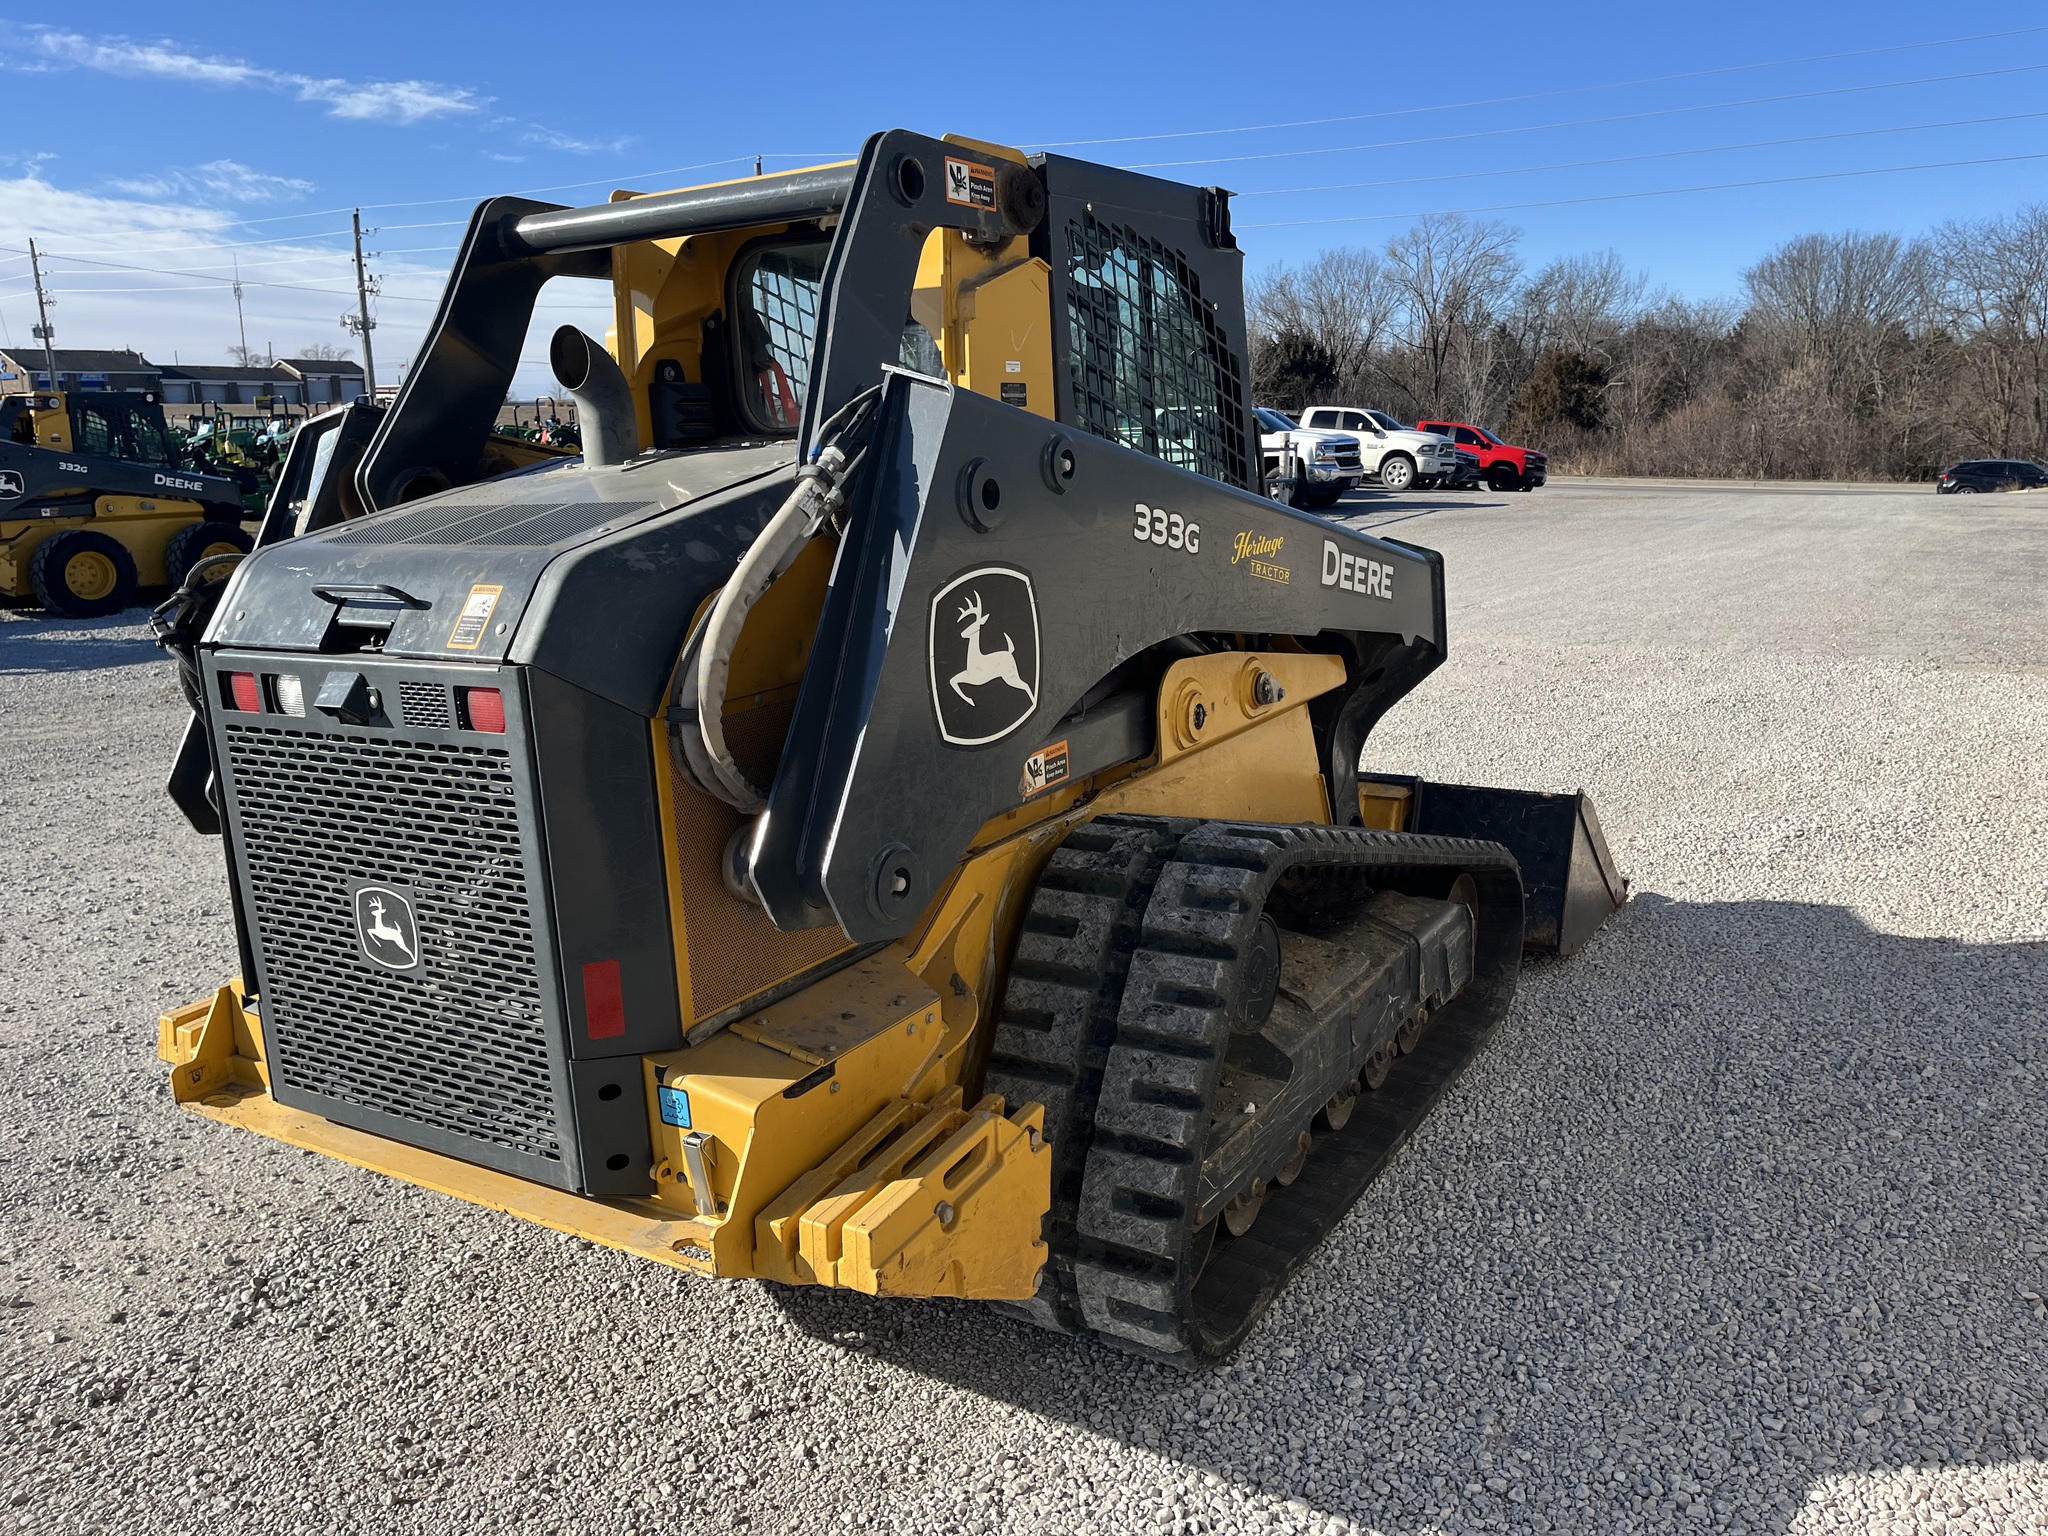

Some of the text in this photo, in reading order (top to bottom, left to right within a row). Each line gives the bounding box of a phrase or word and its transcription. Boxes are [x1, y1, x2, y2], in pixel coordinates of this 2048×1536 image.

[970, 182, 993, 194] Pinch Area
[980, 194, 991, 203] Away
[58, 461, 88, 474] 332G
[154, 473, 204, 492] DEERE
[1133, 503, 1200, 554] 333G
[1231, 529, 1284, 565] Heritage
[1250, 562, 1290, 582] TRACTOR
[1321, 539, 1394, 600] DEERE
